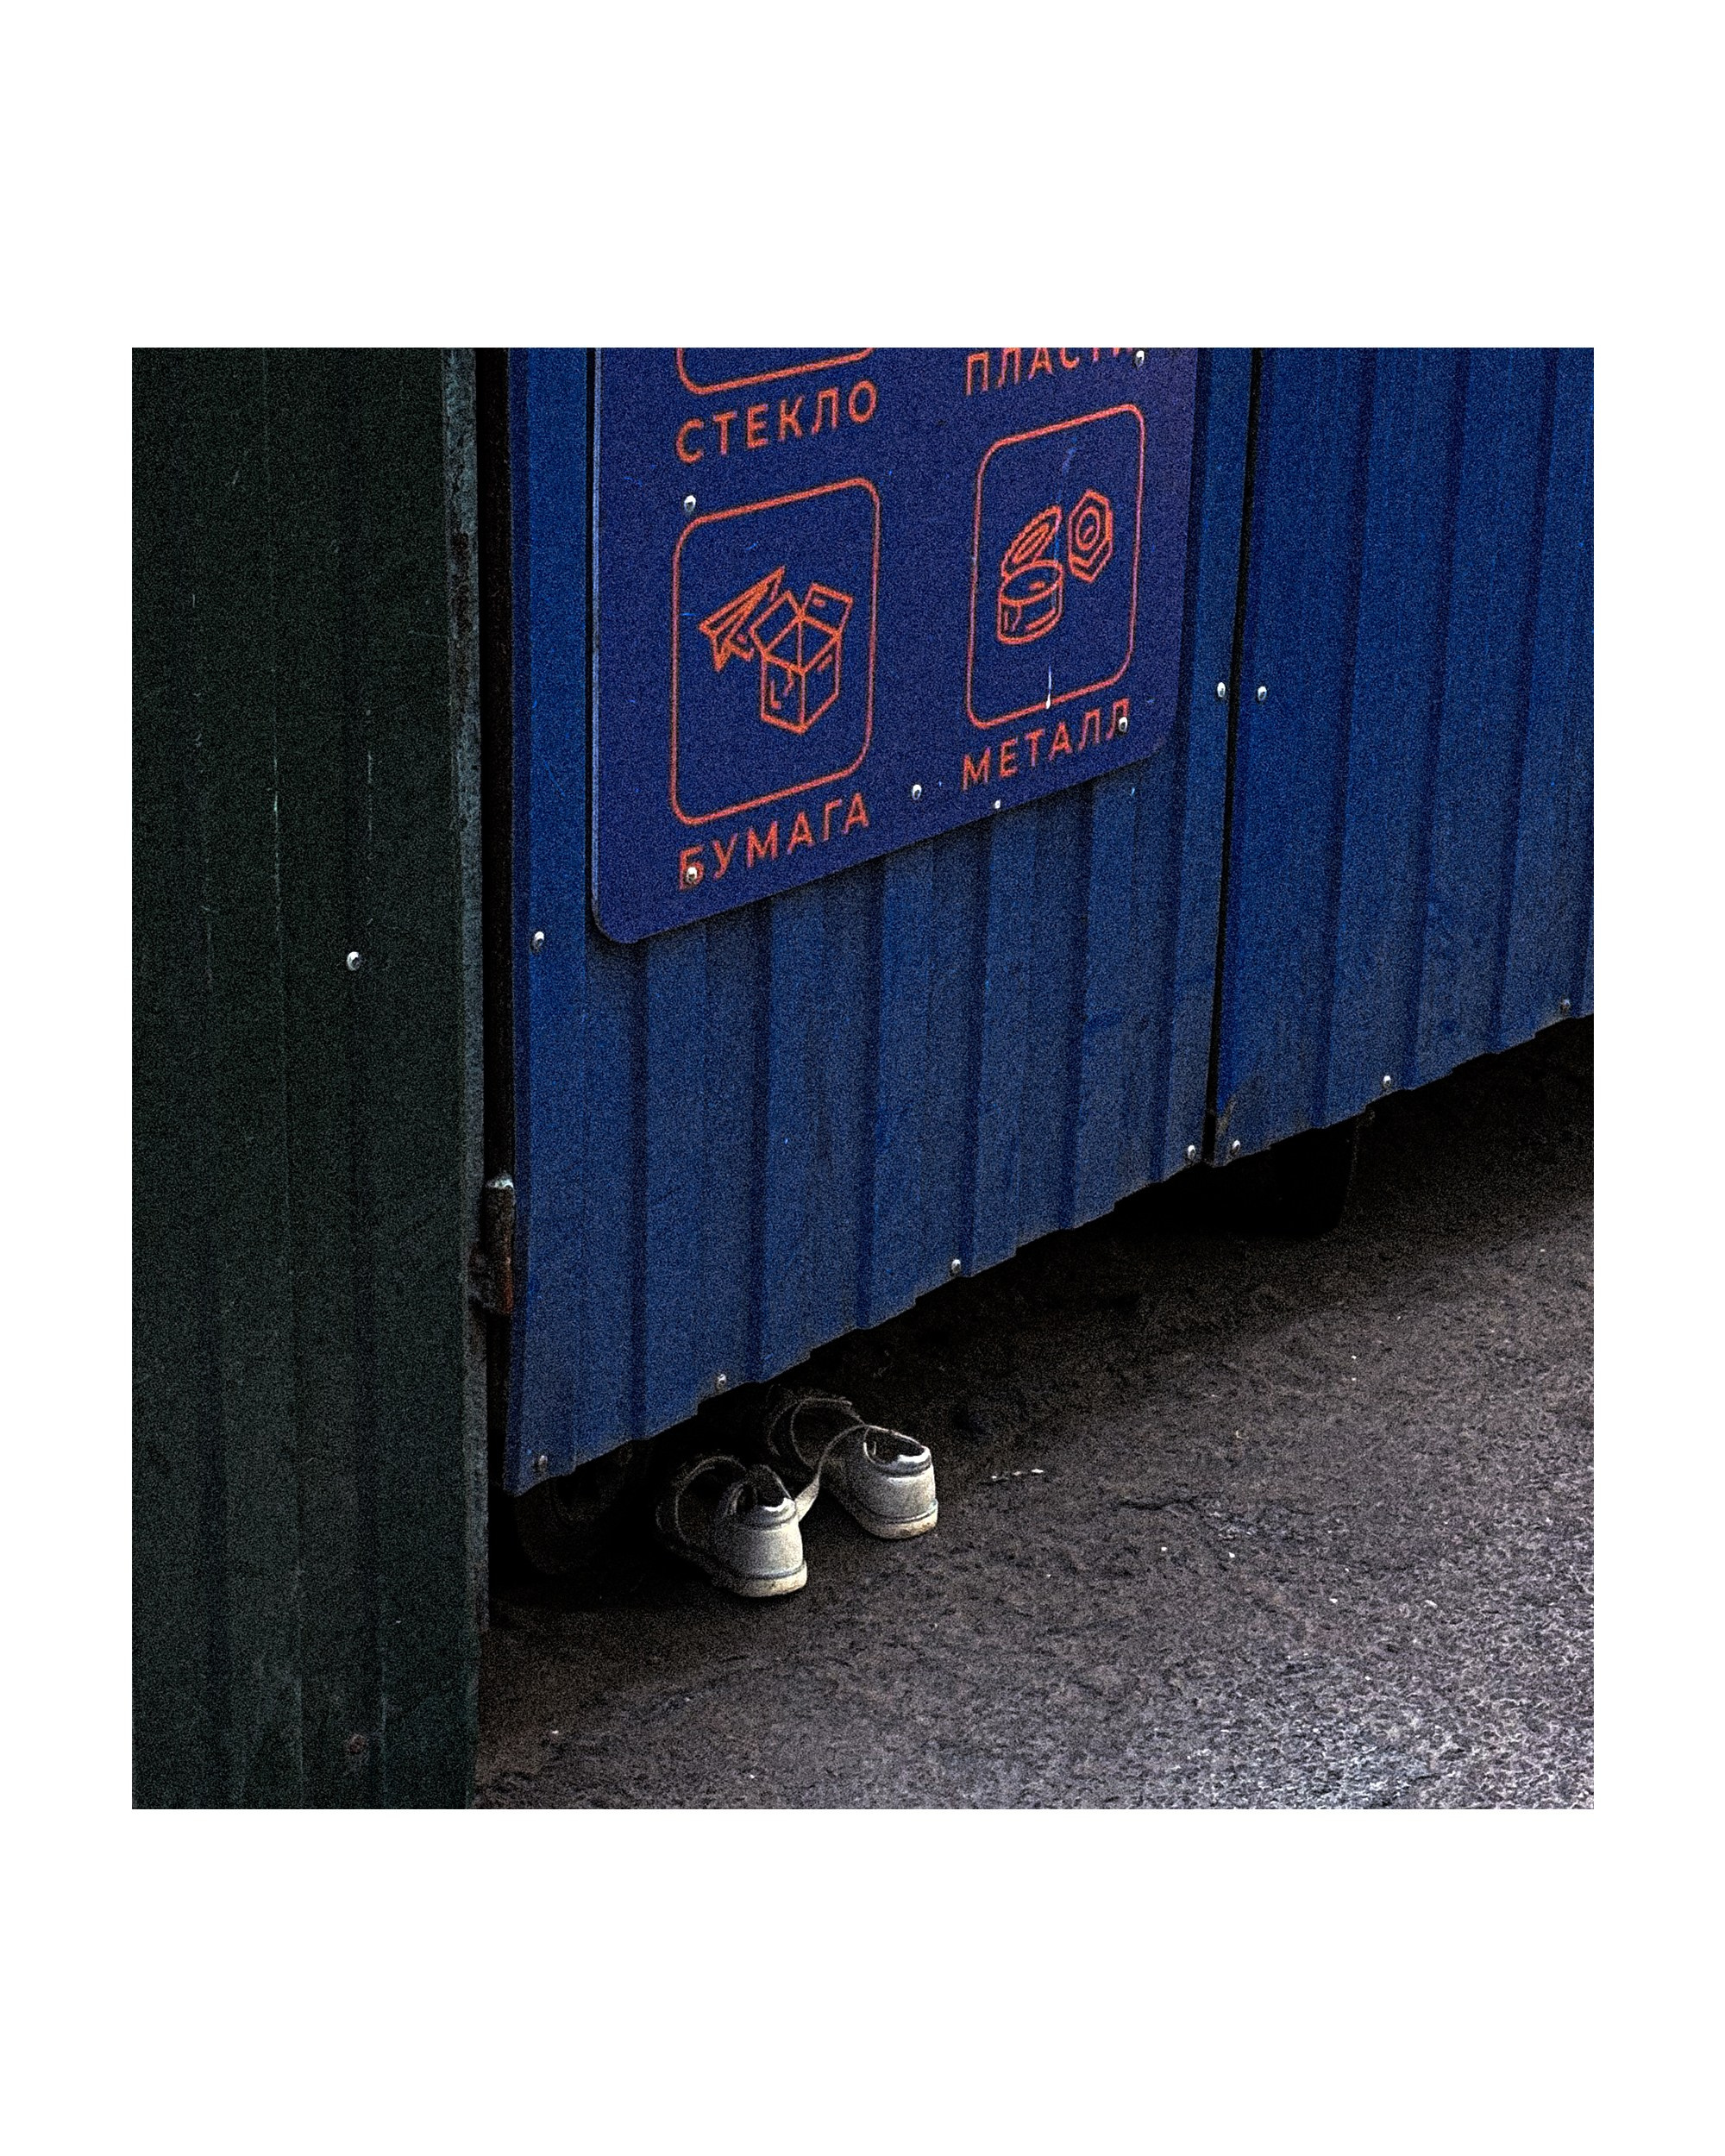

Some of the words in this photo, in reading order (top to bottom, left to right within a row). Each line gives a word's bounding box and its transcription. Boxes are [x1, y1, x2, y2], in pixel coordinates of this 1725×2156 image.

[676, 380, 877, 464] СТЕКЛО
[961, 697, 1130, 791] МЕТАЛЛ
[679, 792, 869, 891] БУМАГА
